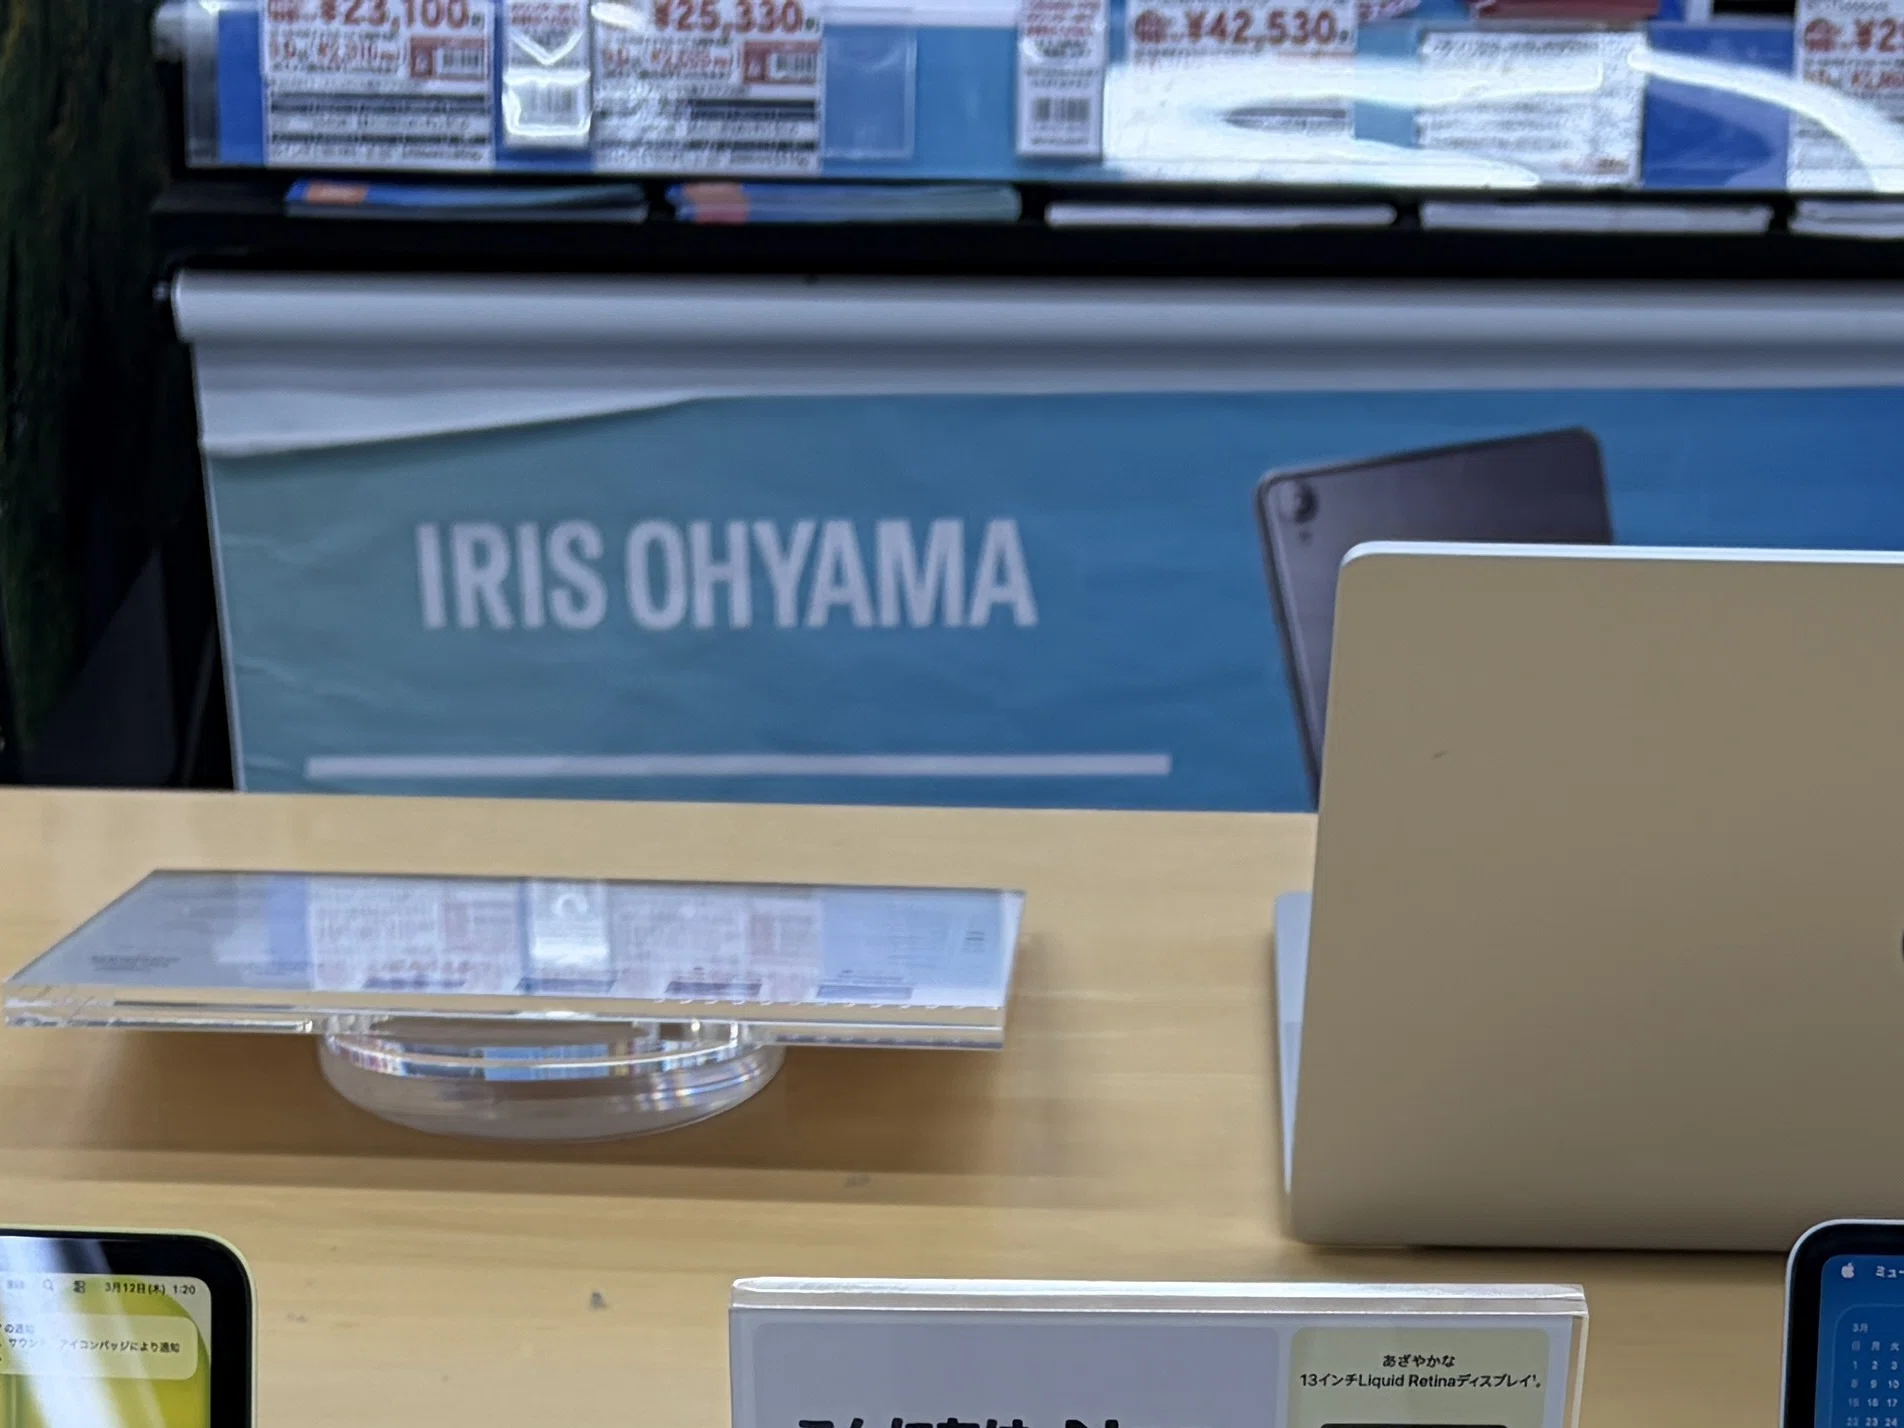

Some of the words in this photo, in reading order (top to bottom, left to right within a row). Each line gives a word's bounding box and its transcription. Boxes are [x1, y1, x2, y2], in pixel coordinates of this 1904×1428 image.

[414, 520, 608, 632] IRIS
[624, 518, 1039, 632] OHYAMA
[173, 1283, 197, 1296] 1:20
[1382, 1354, 1456, 1368] あざやかな
[1300, 1373, 1405, 1388] 13インチLiquid
